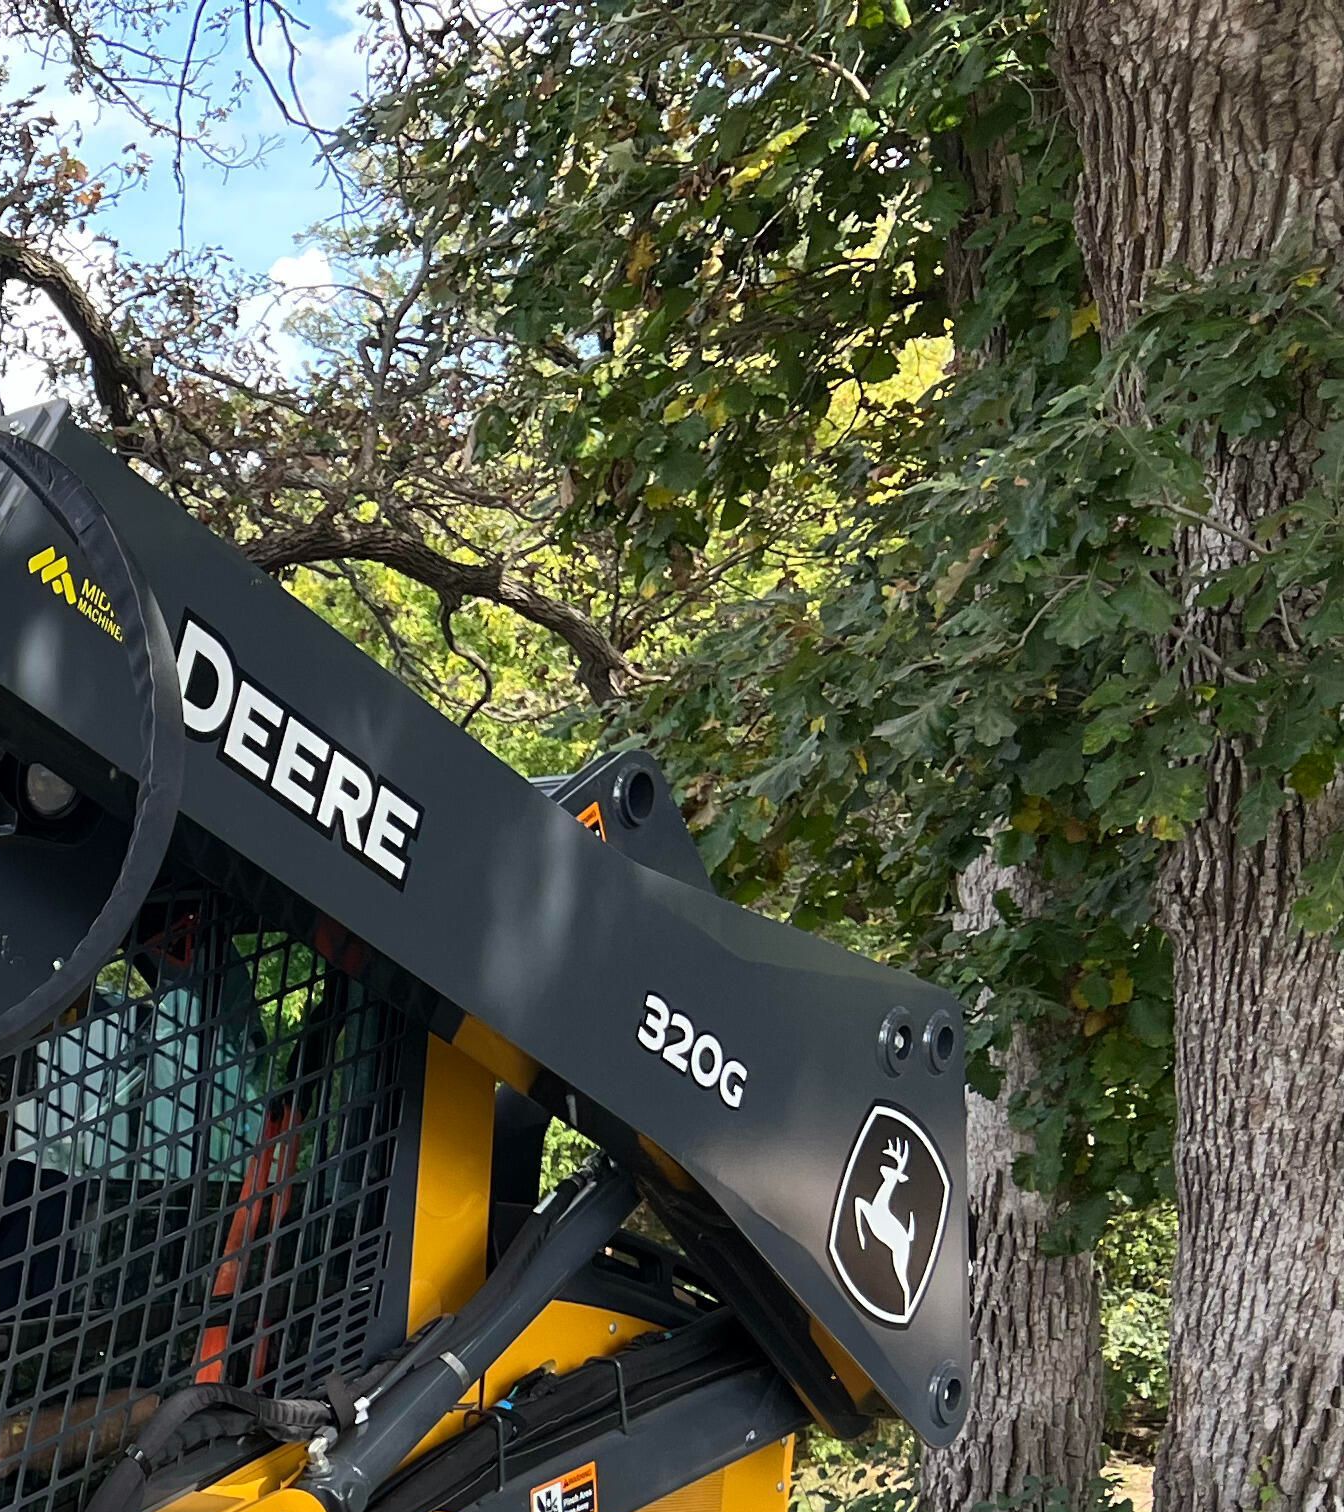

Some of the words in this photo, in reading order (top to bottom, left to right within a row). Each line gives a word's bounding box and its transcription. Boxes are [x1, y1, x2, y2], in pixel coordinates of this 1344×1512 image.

[77, 597, 123, 642] MACHINE
[176, 619, 419, 880] DEERE
[637, 994, 748, 1108] 320G
